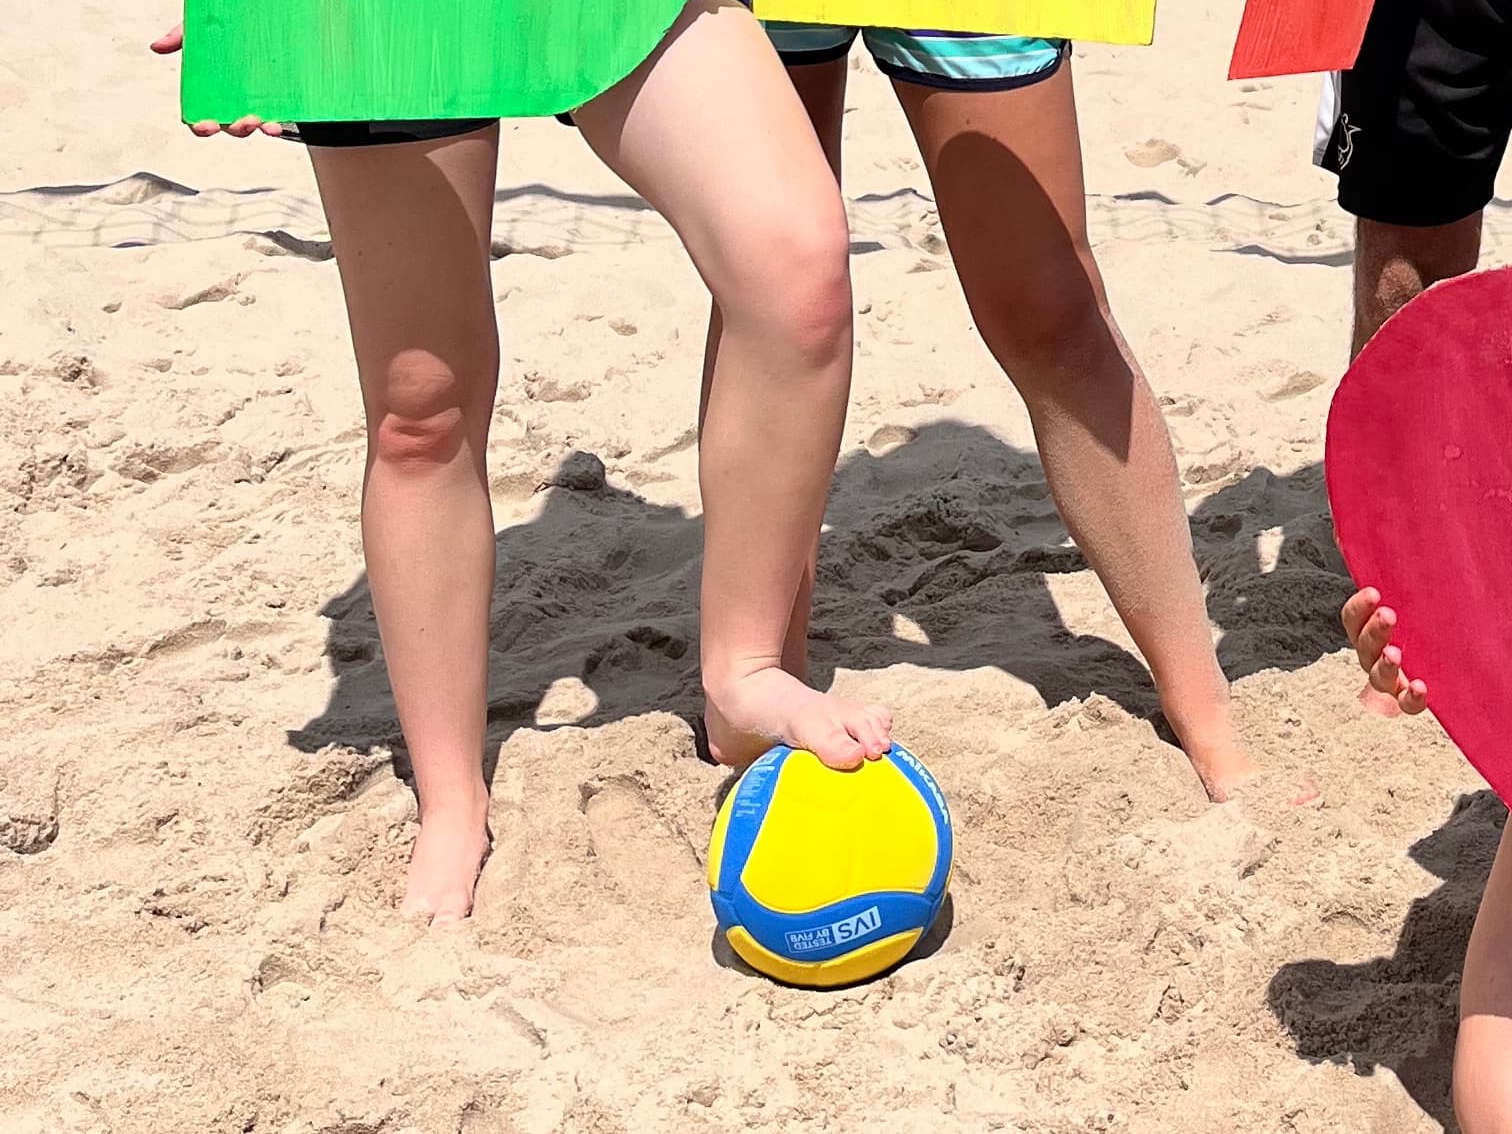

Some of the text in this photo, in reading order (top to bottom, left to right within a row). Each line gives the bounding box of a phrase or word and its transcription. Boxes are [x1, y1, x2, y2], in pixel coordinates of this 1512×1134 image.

[838, 911, 877, 940] IVS
[790, 928, 830, 943] BY FIVB
[794, 937, 832, 950] TESTED
